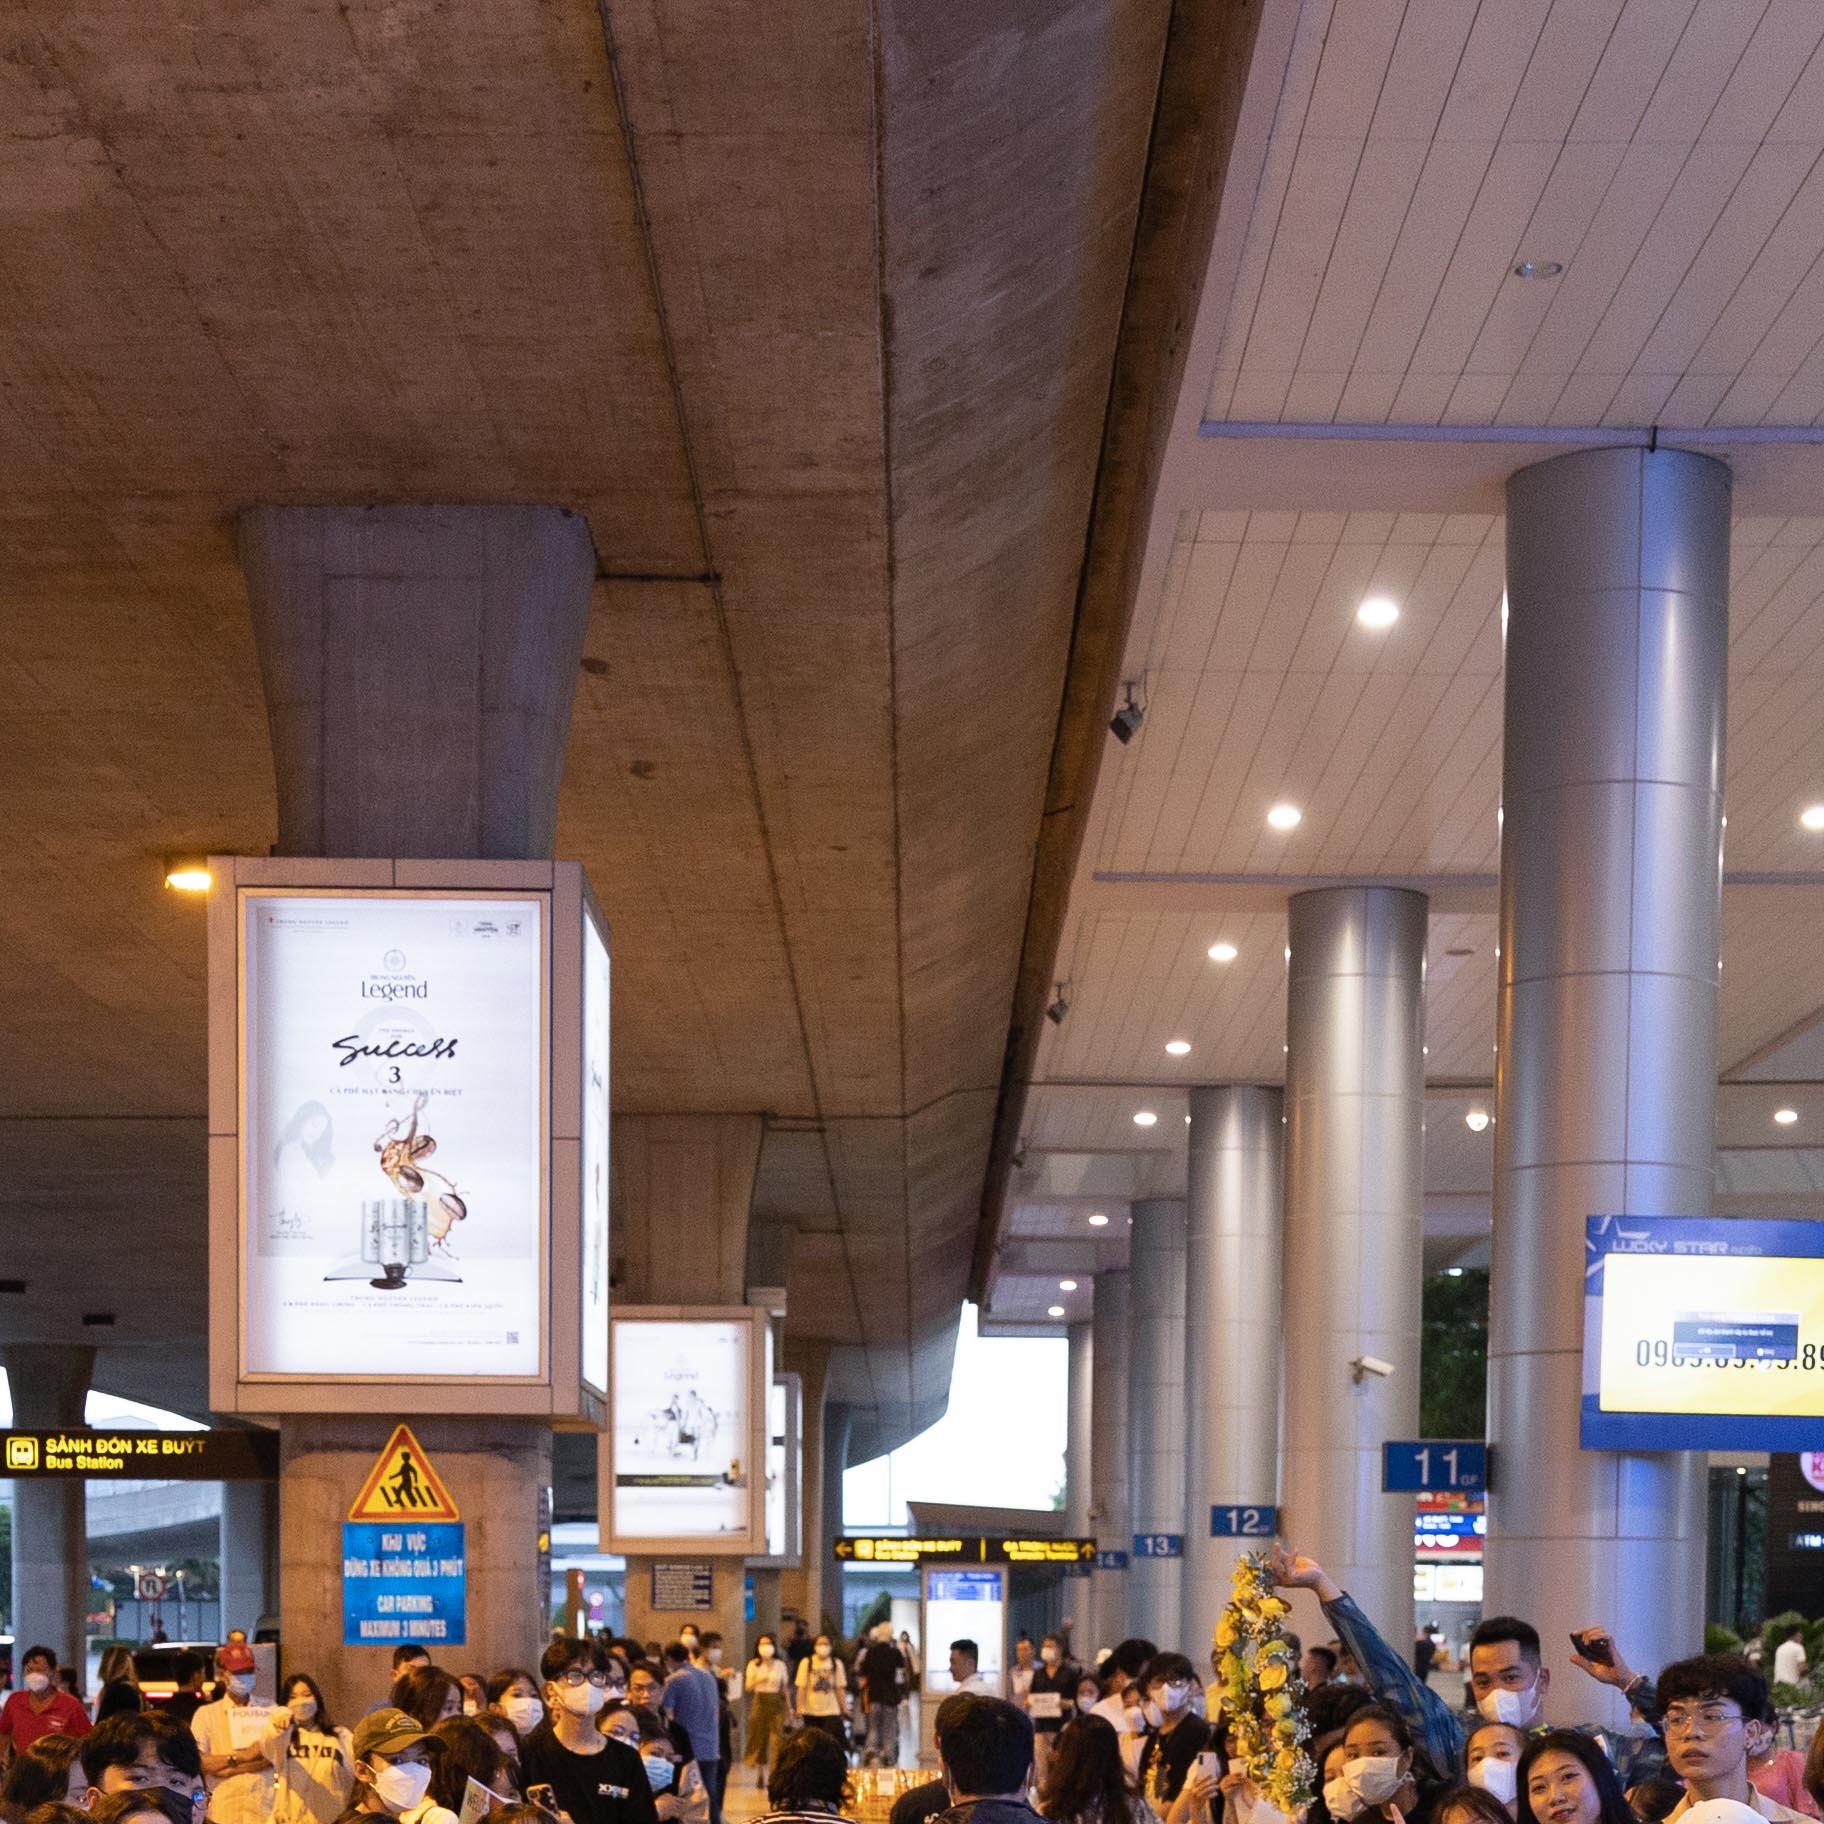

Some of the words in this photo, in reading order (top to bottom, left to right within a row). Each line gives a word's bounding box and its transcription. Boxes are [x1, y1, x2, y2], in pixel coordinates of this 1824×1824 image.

[362, 980, 428, 1001] Legend
[332, 1035, 458, 1067] Success
[389, 1066, 401, 1084] 3
[46, 1435, 92, 1453] SẢNH
[96, 1436, 132, 1453] ĐÓN
[136, 1439, 158, 1453] XE
[46, 1455, 73, 1469] Bus
[76, 1455, 123, 1469] Station
[1415, 1449, 1457, 1485] 11
[1227, 1509, 1259, 1533] 12
[1144, 1536, 1168, 1555] 13
